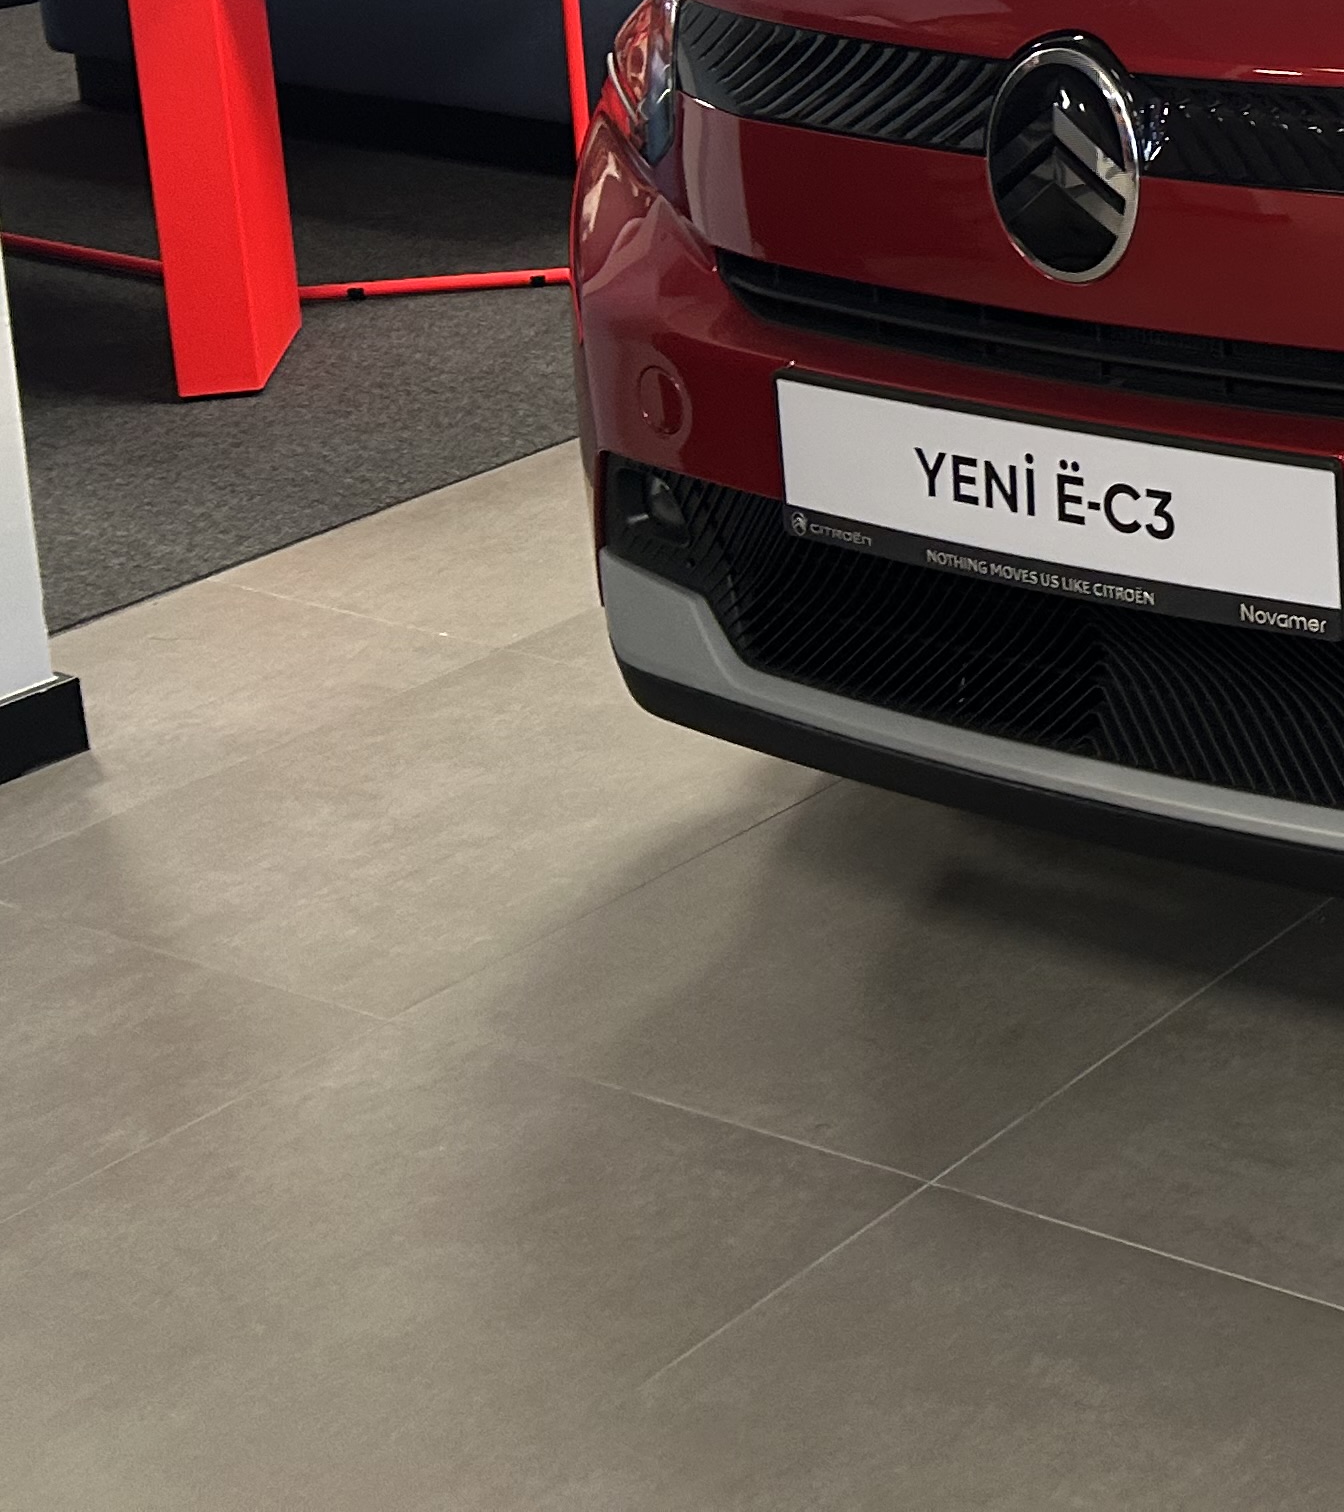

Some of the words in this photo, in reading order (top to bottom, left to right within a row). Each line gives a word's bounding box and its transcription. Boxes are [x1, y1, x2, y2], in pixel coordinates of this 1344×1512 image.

[914, 446, 1036, 517] YENİ
[1056, 458, 1176, 540] Ë-C3
[926, 548, 988, 576] NOTHING
[989, 562, 1038, 586] MOVES
[1040, 571, 1060, 589] US
[1061, 576, 1092, 595] LIKE
[1093, 581, 1155, 607] CITROËN
[1239, 603, 1327, 635] Novamer
